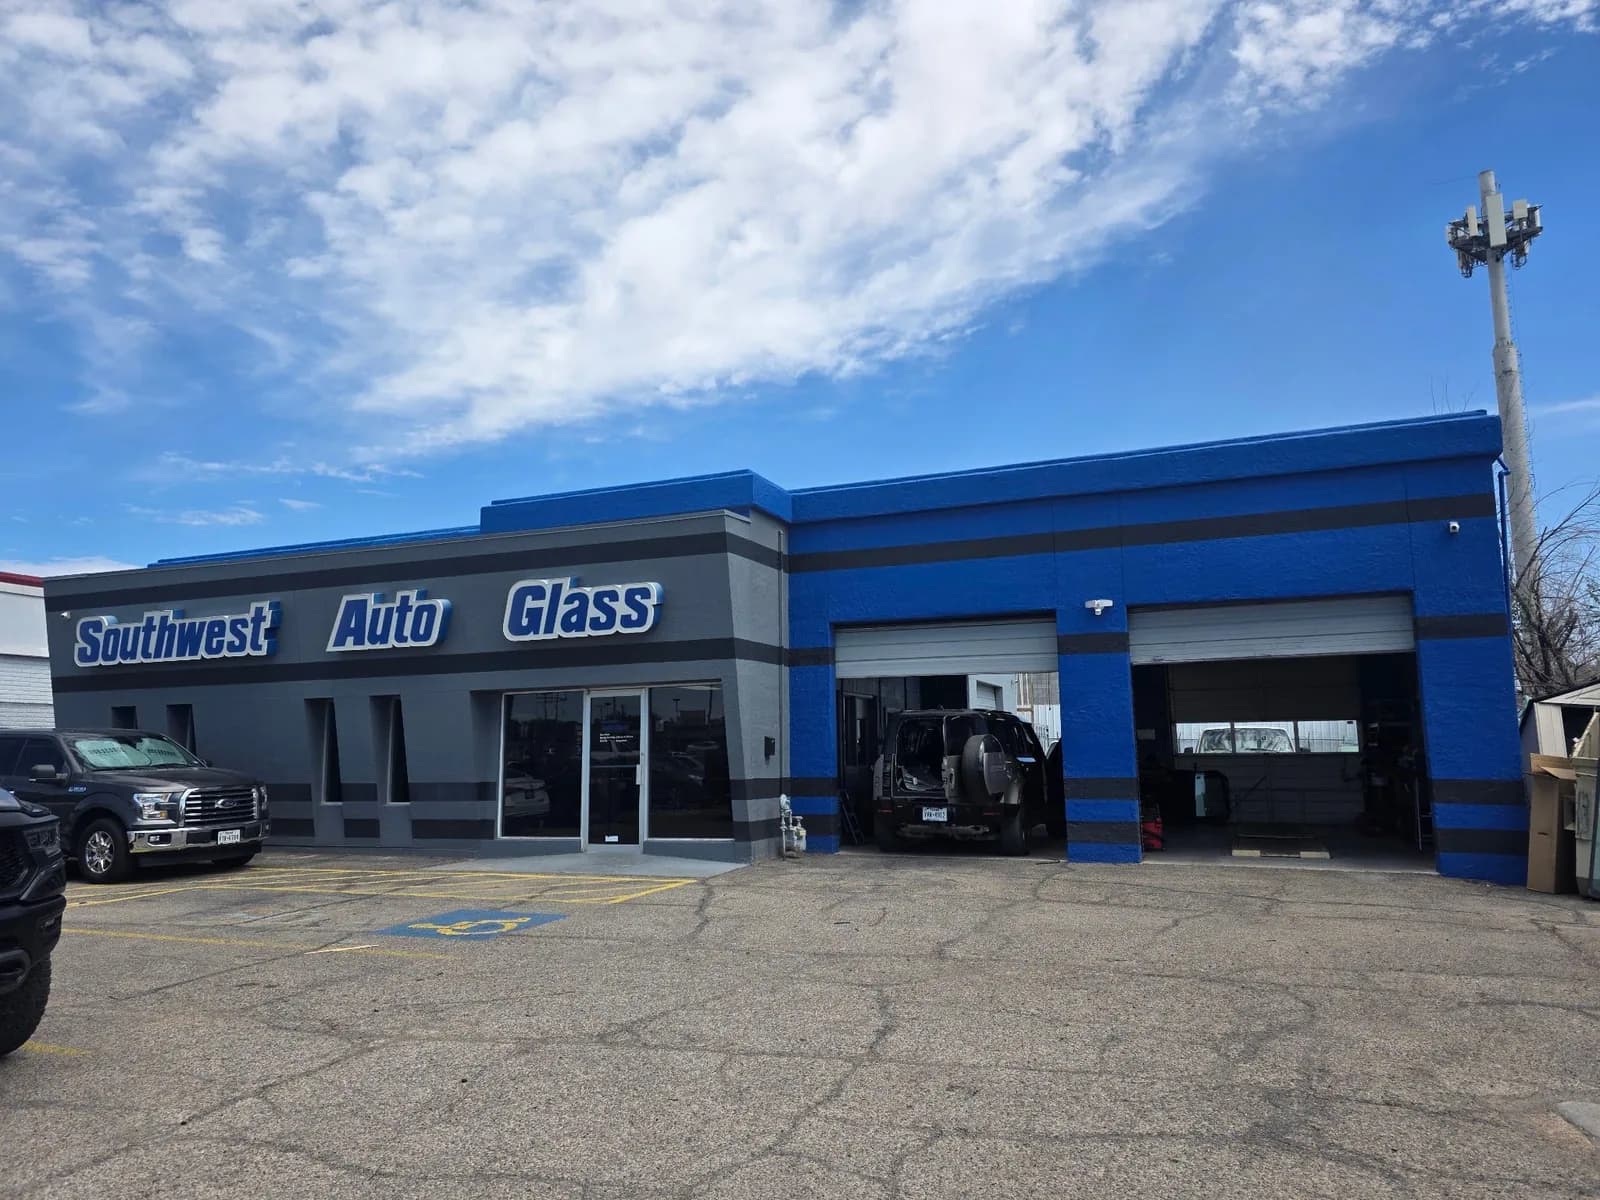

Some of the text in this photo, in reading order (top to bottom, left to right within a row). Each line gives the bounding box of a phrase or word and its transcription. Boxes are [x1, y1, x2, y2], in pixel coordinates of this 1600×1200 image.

[75, 578, 659, 666] Southwest Auto Glass
